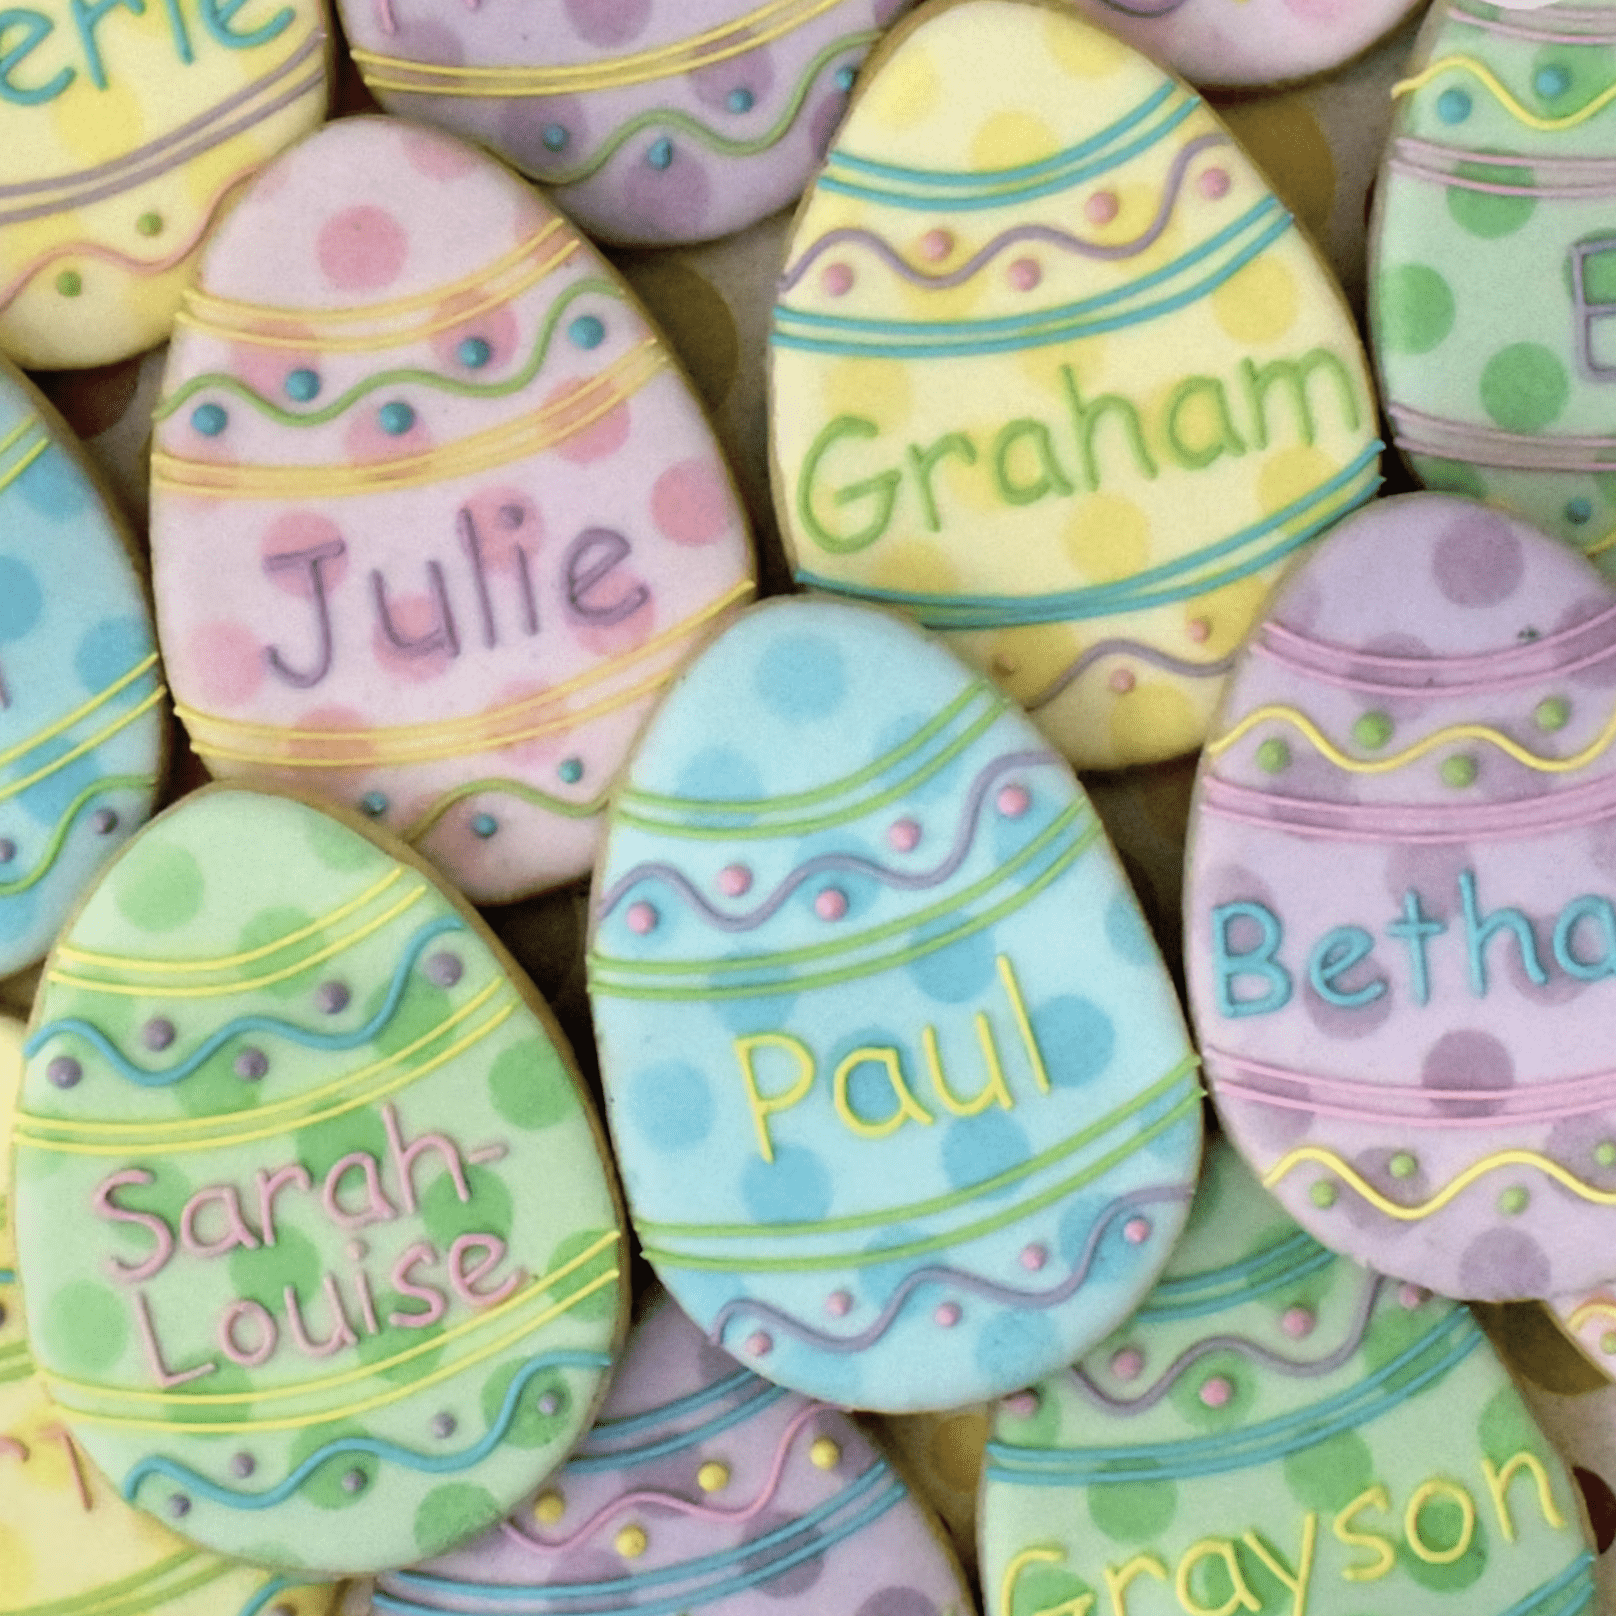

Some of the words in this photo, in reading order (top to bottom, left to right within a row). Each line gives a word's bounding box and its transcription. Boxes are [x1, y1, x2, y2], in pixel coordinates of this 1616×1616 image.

[797, 347, 1361, 555] Graham
[262, 503, 651, 689] Julie
[733, 952, 1052, 1165] Paul
[93, 1101, 509, 1283] Sarah-
[134, 1233, 530, 1389] Louise
[1000, 1450, 1568, 1616] Grayson
